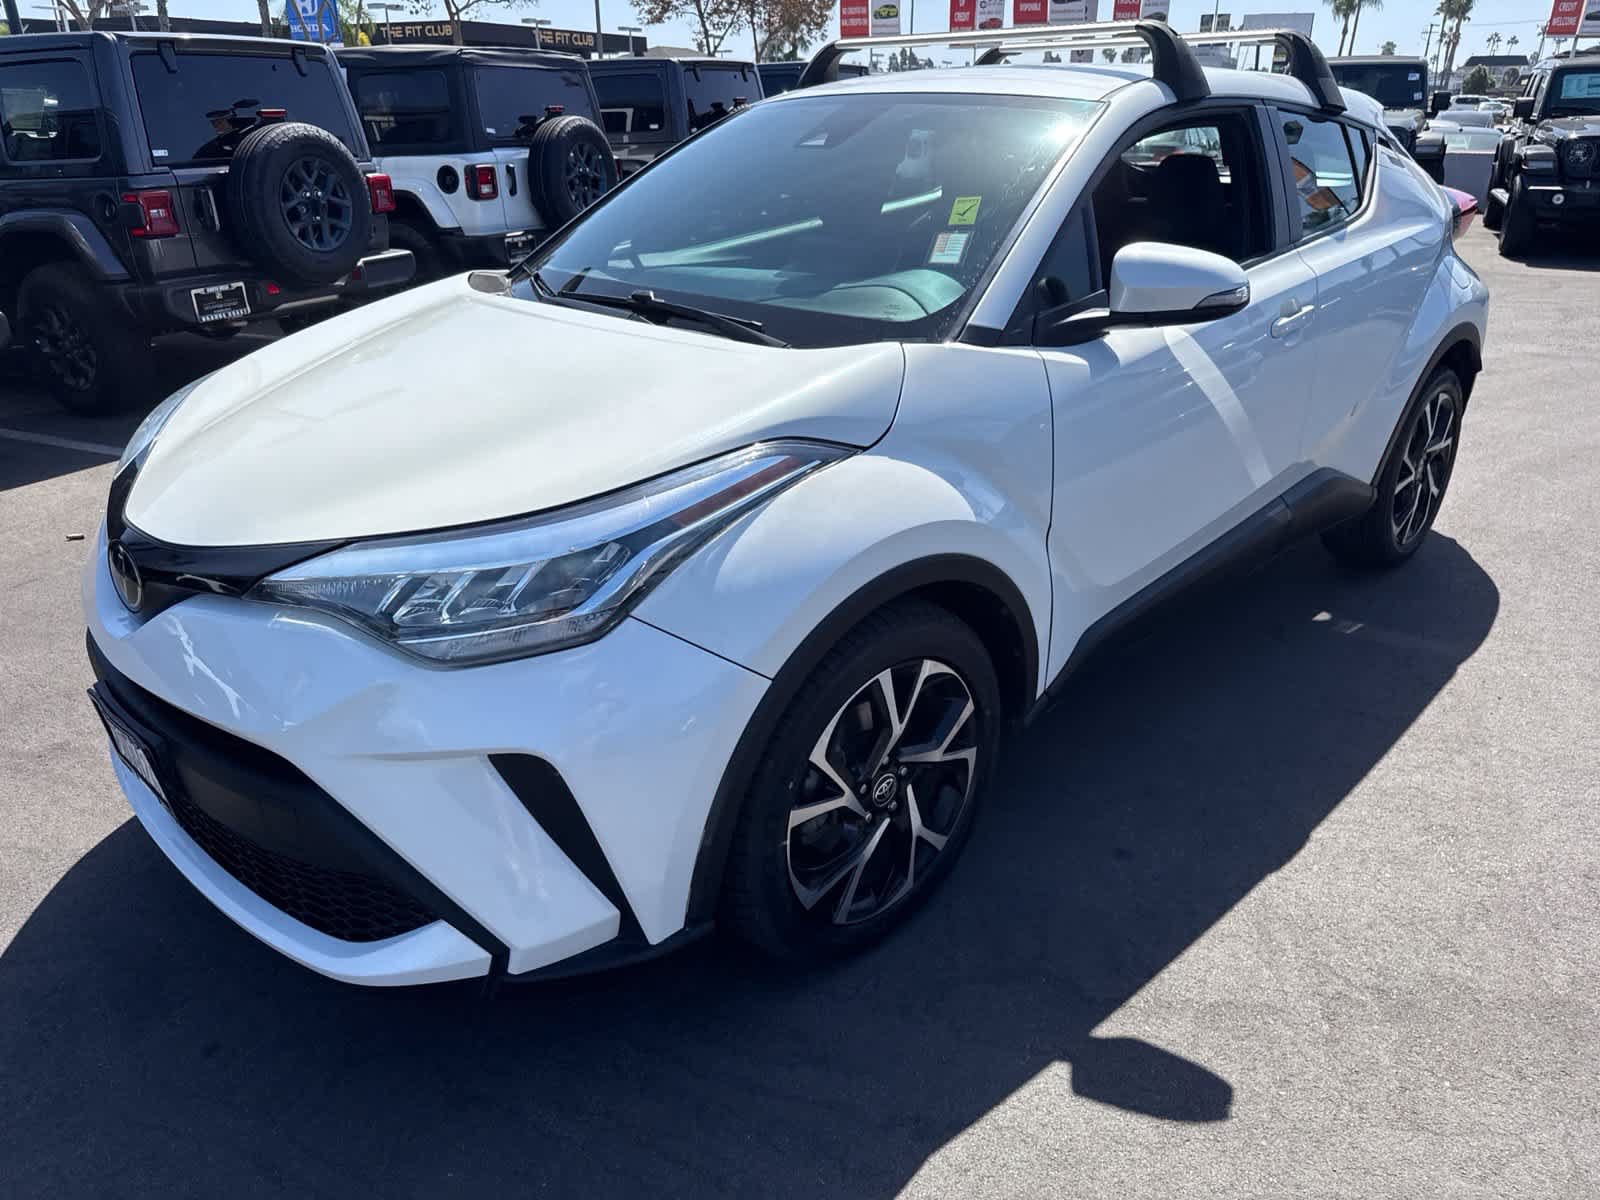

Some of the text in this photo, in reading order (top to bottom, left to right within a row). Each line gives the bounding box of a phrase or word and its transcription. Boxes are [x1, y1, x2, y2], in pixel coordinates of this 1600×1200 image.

[405, 25, 422, 37] FIT
[425, 24, 453, 37] CLUB
[555, 32, 570, 44] FIT
[572, 33, 595, 46] CLUB
